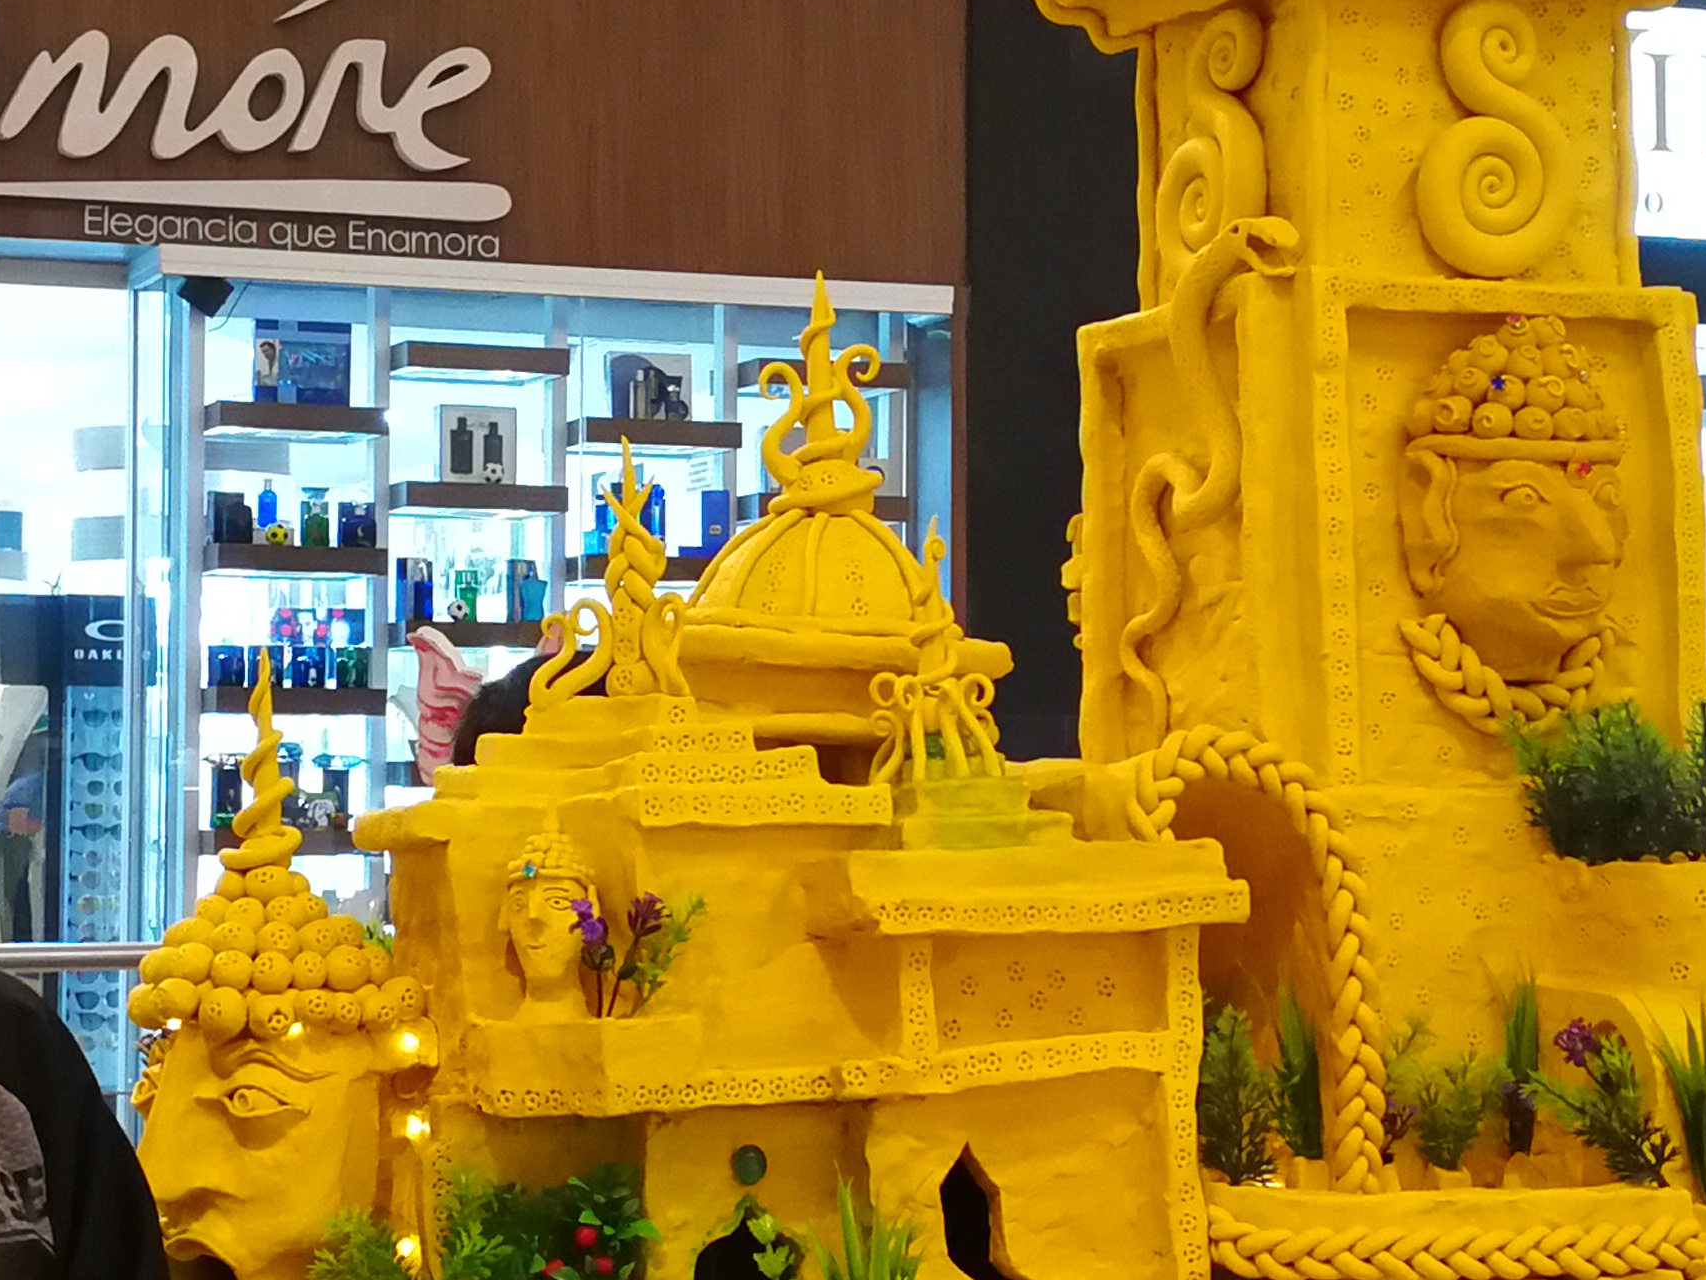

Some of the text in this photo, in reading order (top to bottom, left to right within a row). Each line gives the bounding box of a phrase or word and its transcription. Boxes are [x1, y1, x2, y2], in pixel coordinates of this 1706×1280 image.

[83, 204, 500, 258] Elegancia que Enamora
